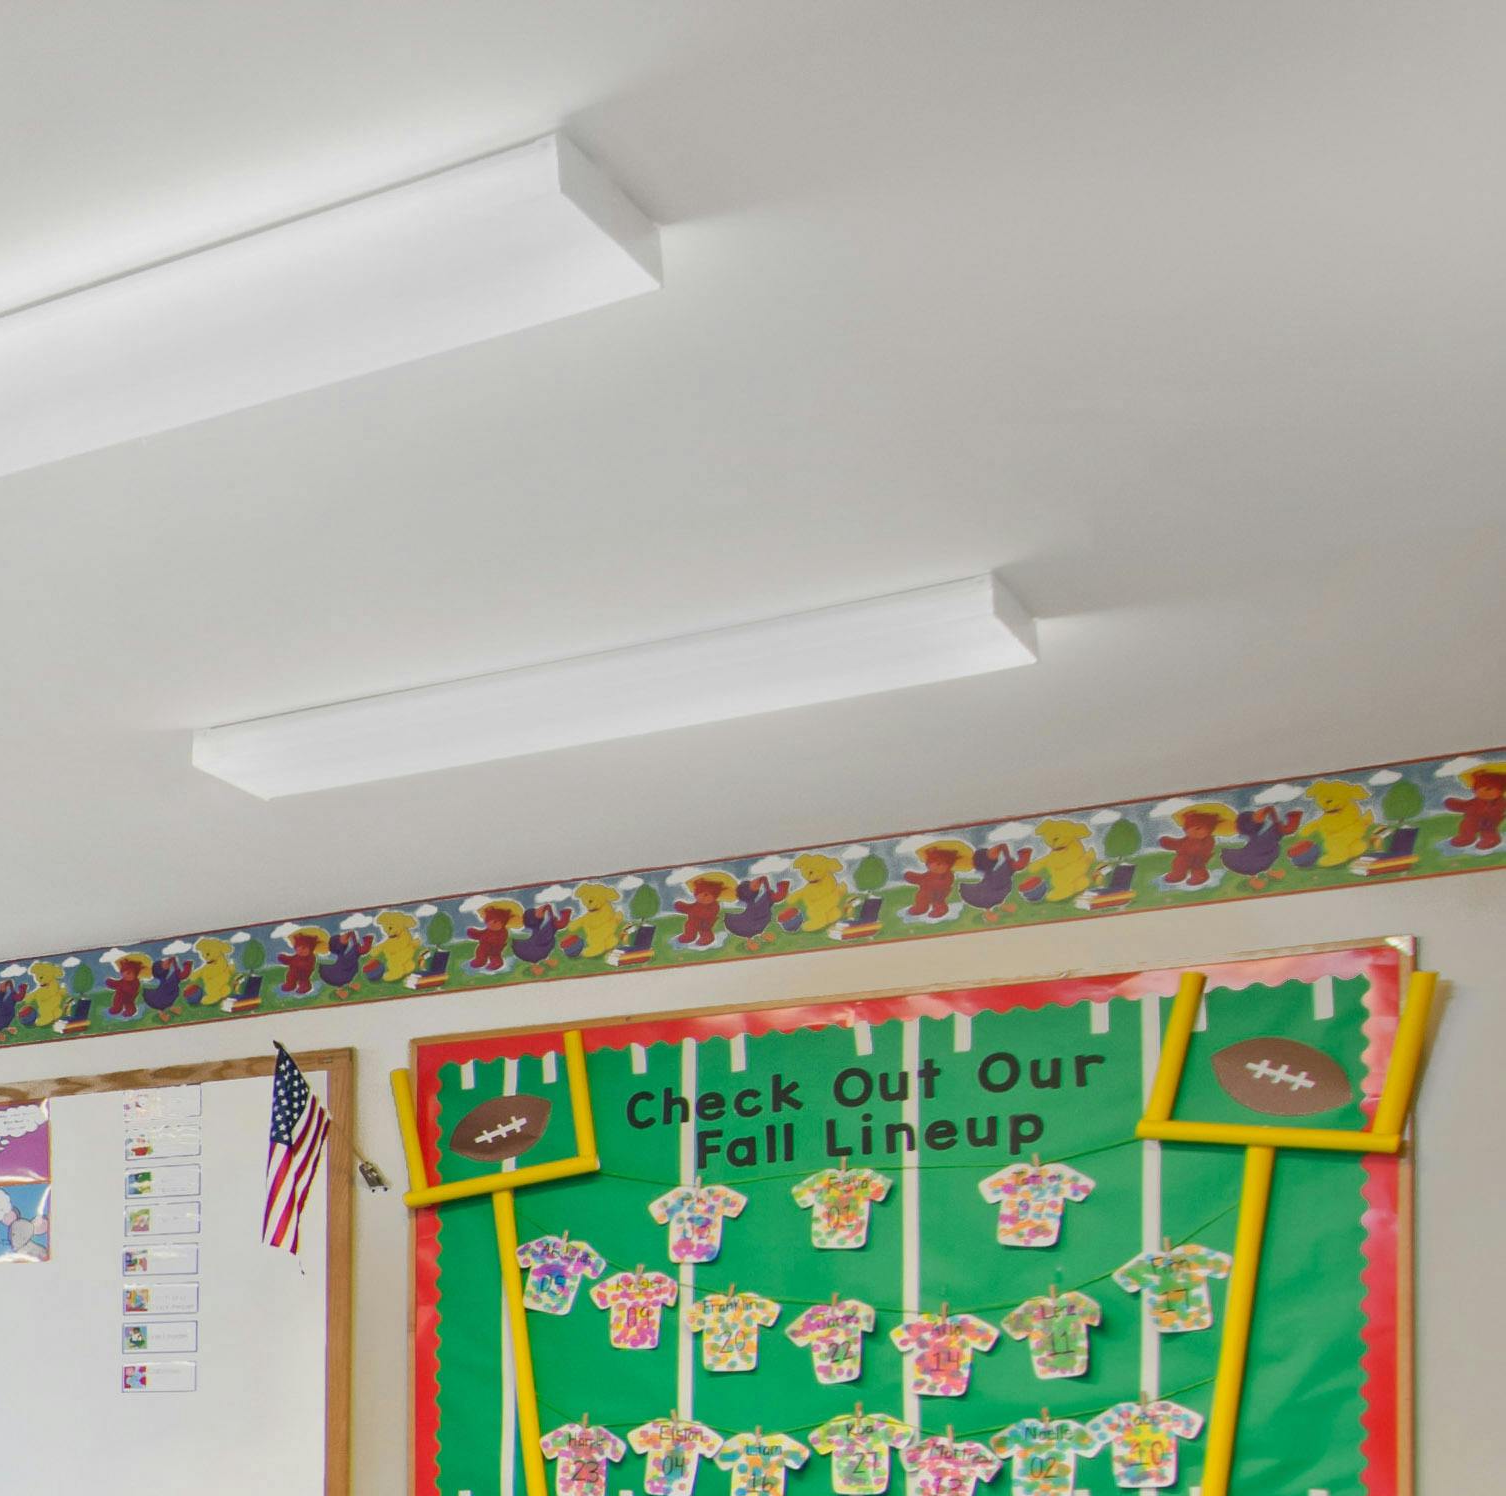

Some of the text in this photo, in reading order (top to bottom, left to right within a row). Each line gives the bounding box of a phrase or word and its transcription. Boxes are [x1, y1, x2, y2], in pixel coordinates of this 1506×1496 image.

[626, 1051, 1105, 1129] Check Out Our
[697, 1112, 1044, 1169] Fall Lineup
[720, 1330, 746, 1353] 20
[827, 1340, 851, 1363] 22
[931, 1352, 960, 1372] 14
[571, 1459, 600, 1483] 23
[1030, 1456, 1058, 1478] 02
